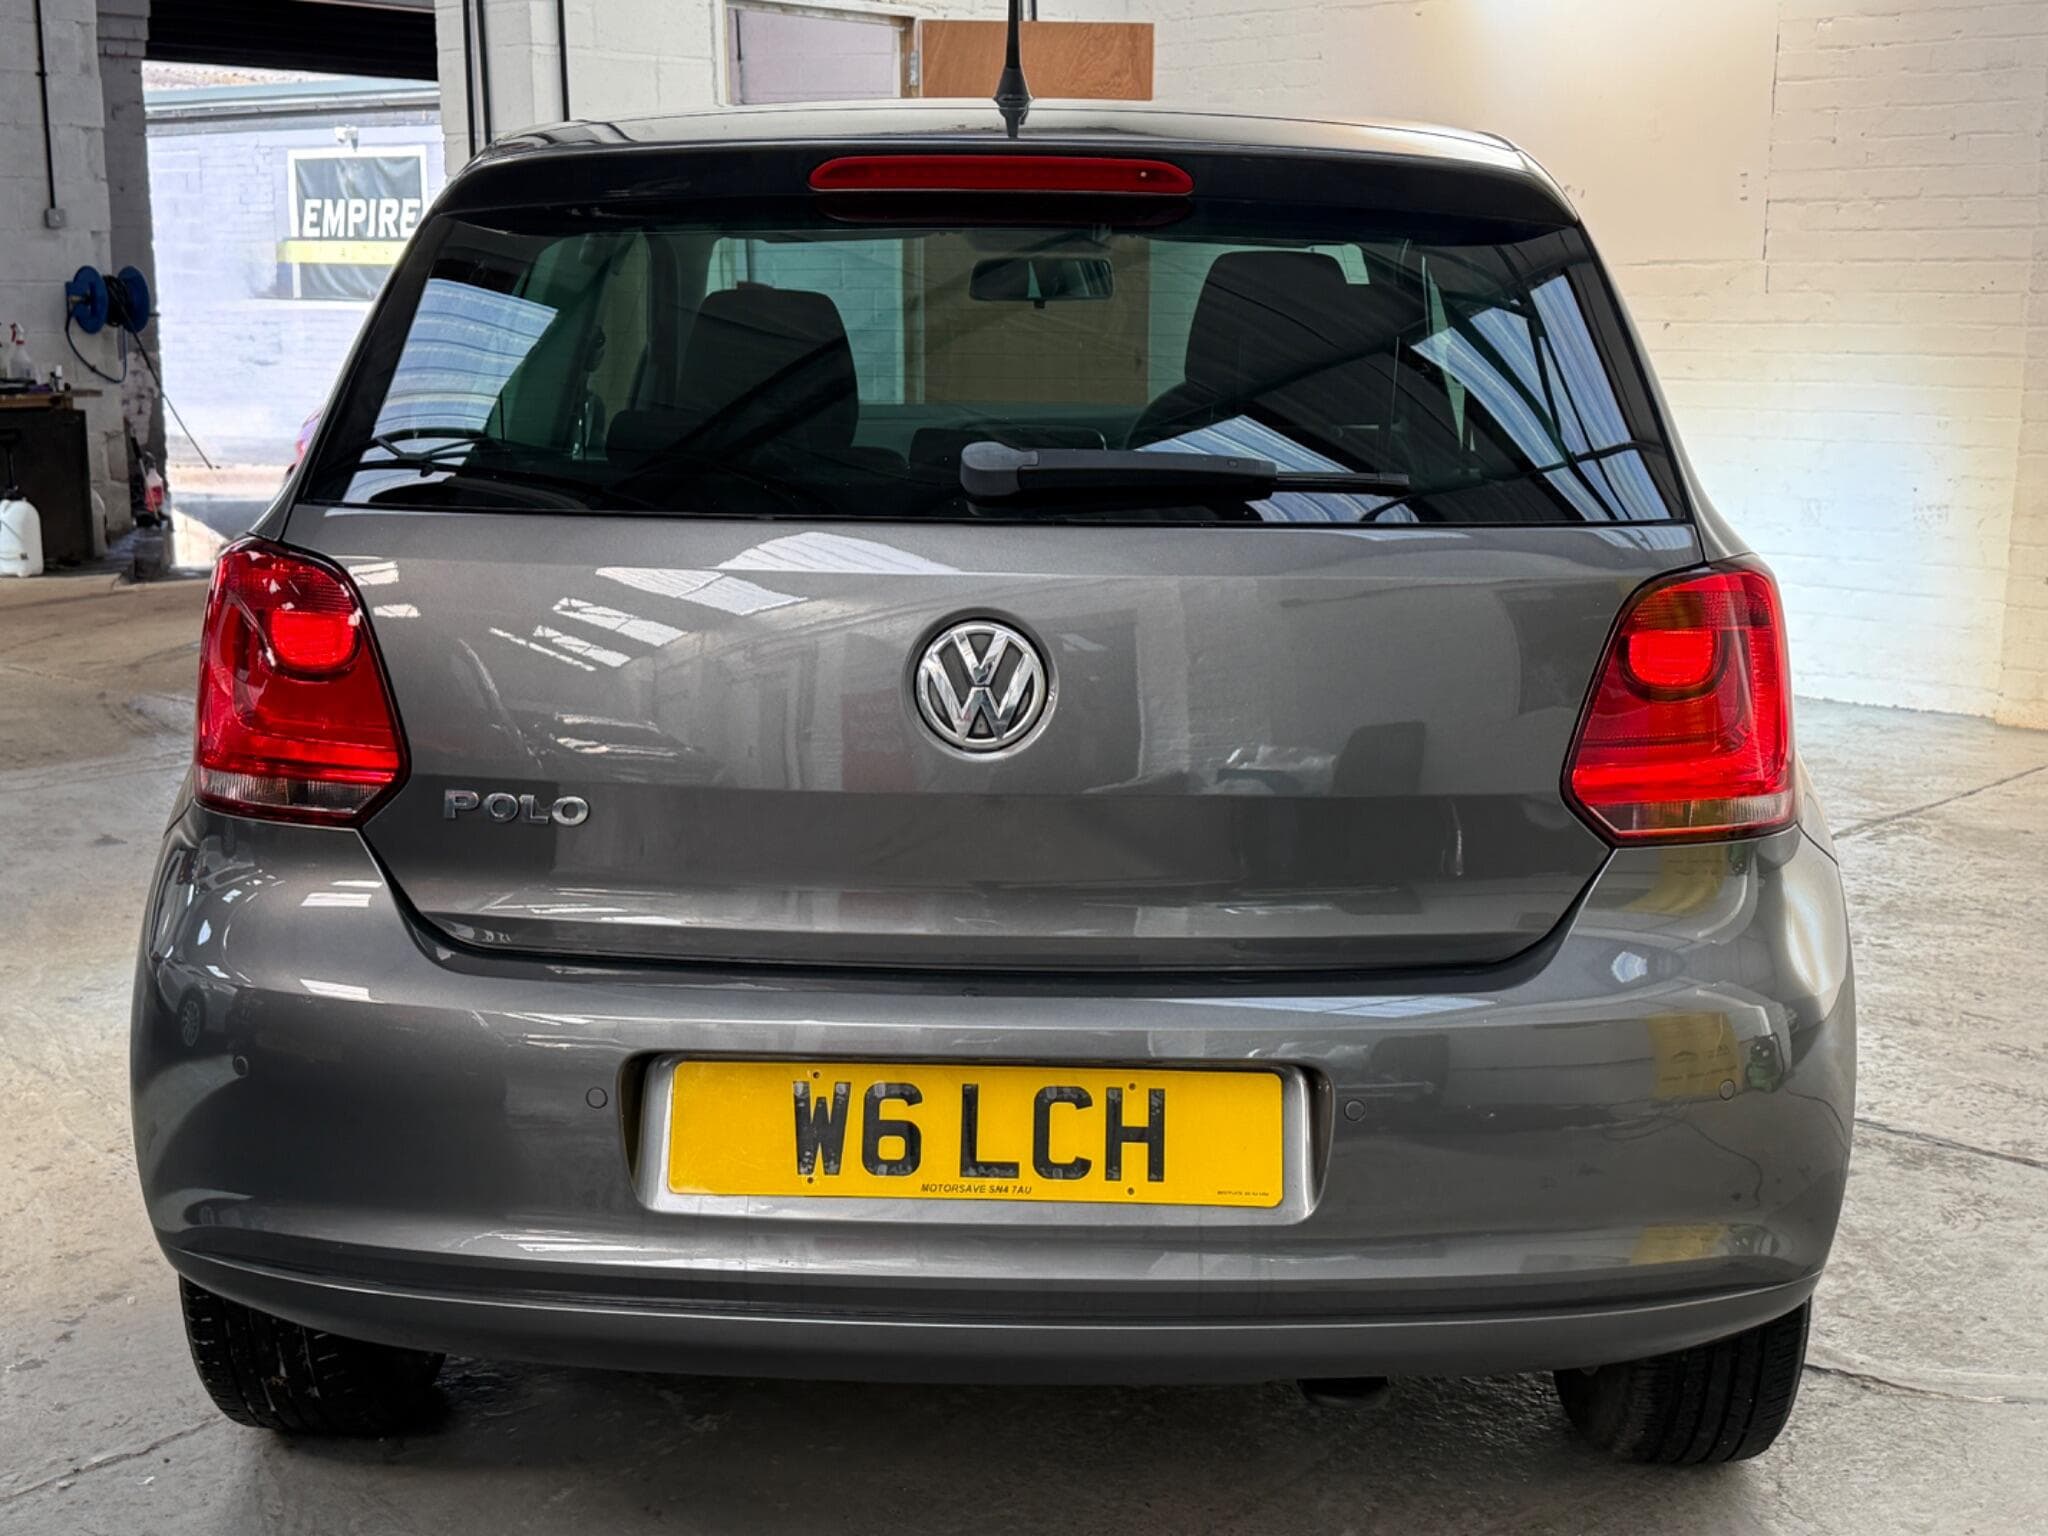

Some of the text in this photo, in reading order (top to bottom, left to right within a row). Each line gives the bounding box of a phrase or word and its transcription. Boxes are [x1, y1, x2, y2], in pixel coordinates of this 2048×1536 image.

[302, 198, 421, 239] EMPIRE
[915, 621, 1047, 750] VW
[444, 789, 589, 826] POLO
[793, 1081, 1165, 1182] W6 LCH
[921, 1183, 986, 1194] MOTORSAVE
